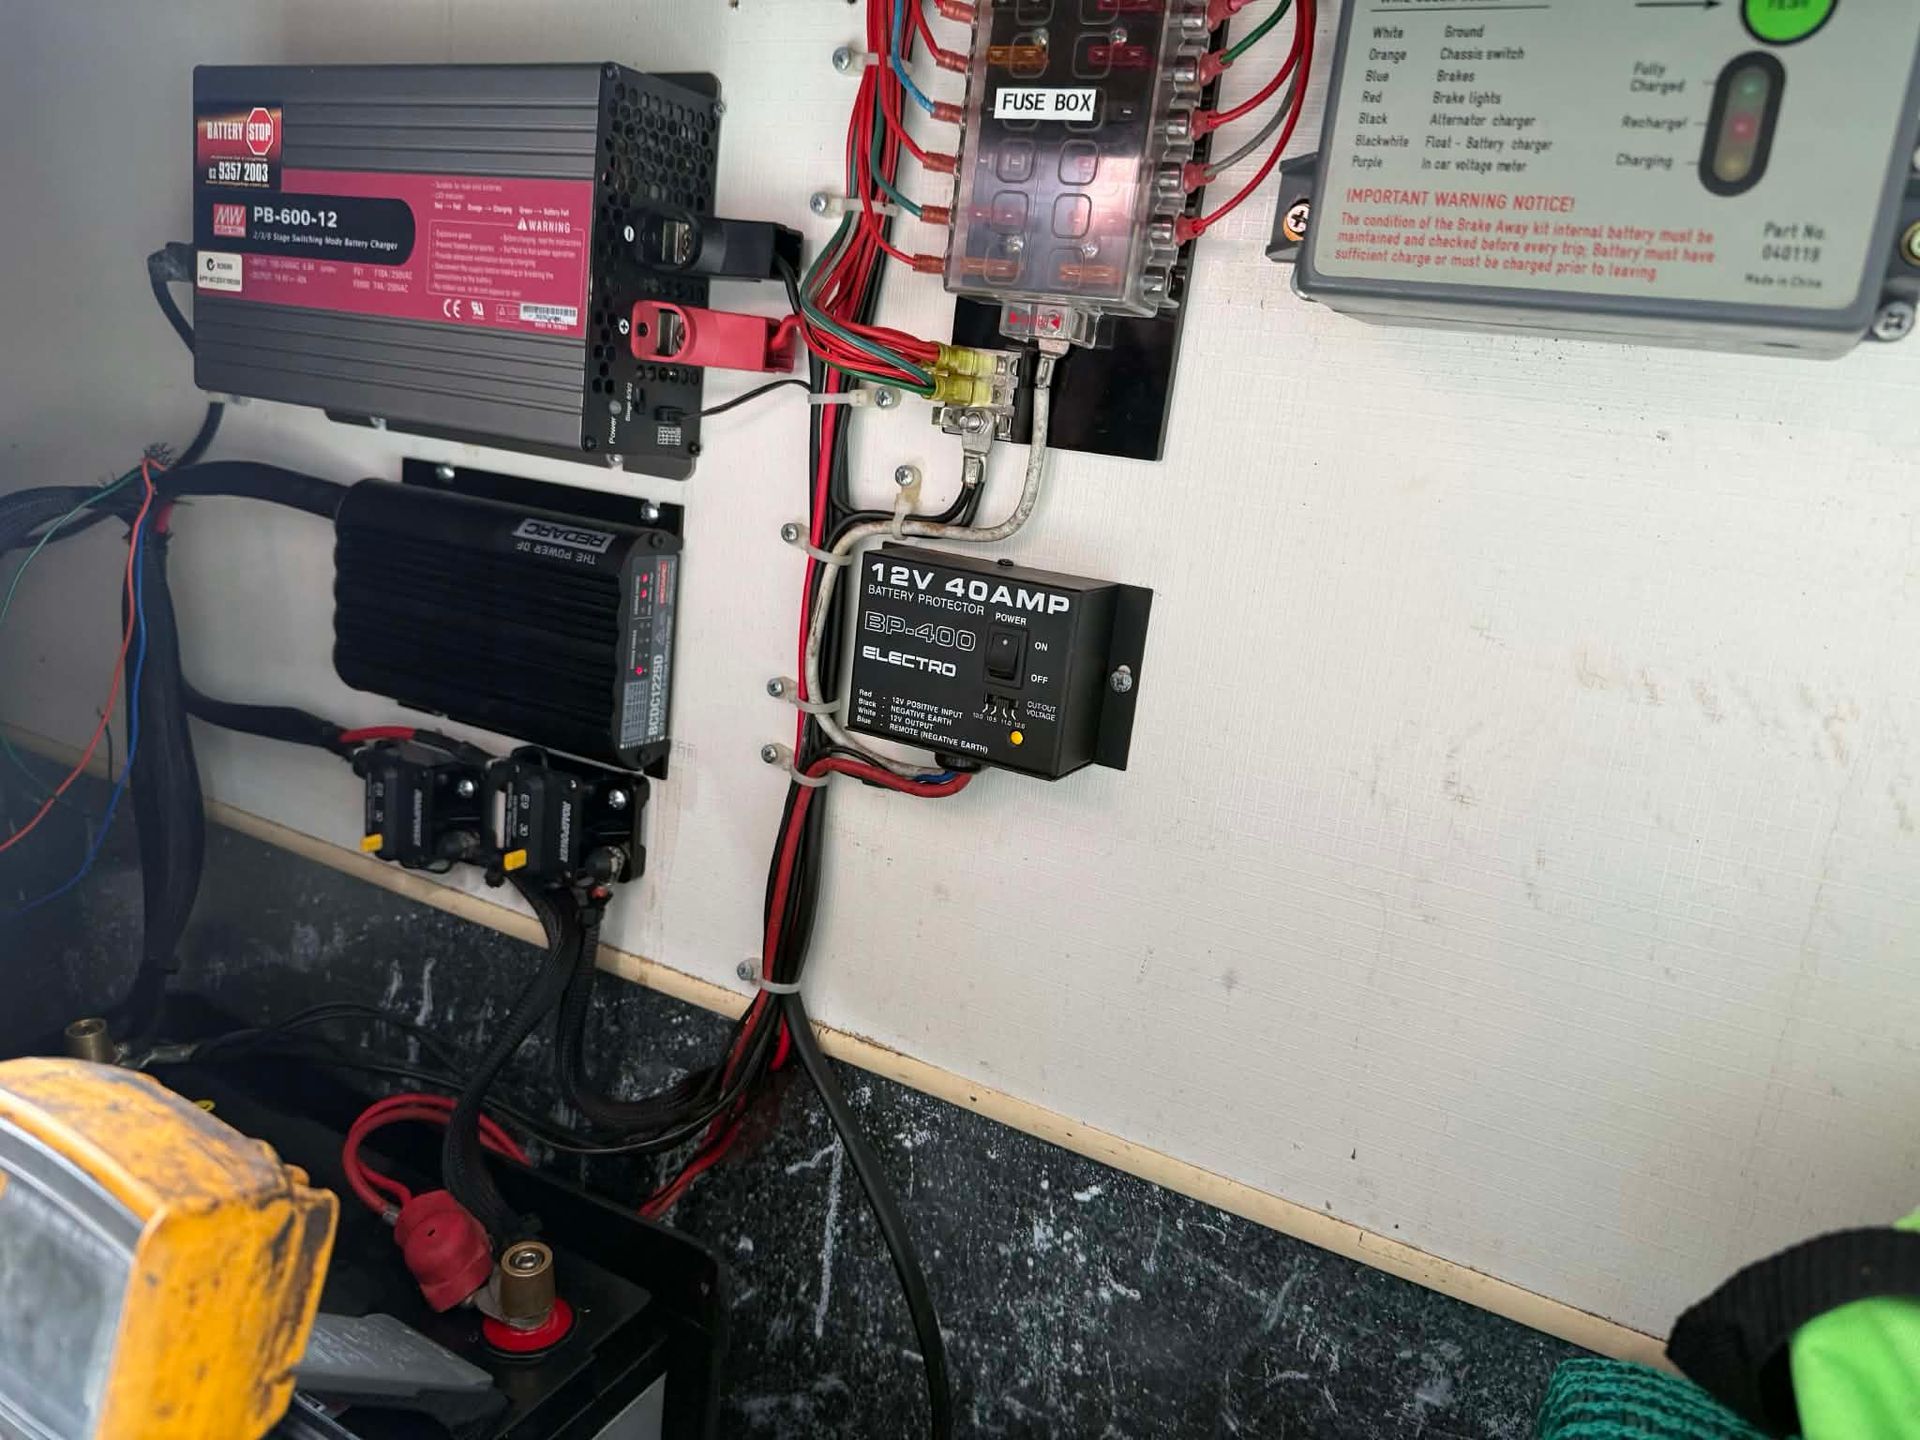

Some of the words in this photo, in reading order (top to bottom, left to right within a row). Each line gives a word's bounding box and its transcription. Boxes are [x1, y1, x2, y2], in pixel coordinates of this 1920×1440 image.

[1373, 26, 1404, 39] White
[1445, 25, 1485, 38] Ground
[1369, 49, 1407, 64] Orange
[1440, 48, 1483, 60] Chassis
[1487, 47, 1525, 60] switch
[1365, 70, 1389, 82] Blue
[1437, 70, 1475, 82] Brakes
[1630, 79, 1686, 96] Charged
[1002, 93, 1046, 111] FUSE
[1054, 94, 1093, 111] BOX
[1362, 91, 1383, 103] Red
[1433, 91, 1465, 104] Brake
[1469, 91, 1501, 107] lights
[1358, 113, 1388, 125] Black
[1429, 113, 1486, 126] Alternator
[1492, 115, 1536, 130] charger
[207, 121, 243, 140] BATTERY
[249, 123, 271, 142] STOP
[1356, 135, 1409, 148] Blackwhite
[1425, 136, 1451, 149] Float
[1465, 137, 1504, 152] Battery
[1511, 138, 1553, 153] charger
[1352, 156, 1383, 169] Purple
[1422, 158, 1432, 170] In
[1434, 160, 1450, 170] car
[1455, 158, 1492, 174] voltage
[1496, 160, 1527, 173] meter
[1616, 152, 1673, 171] Charging
[218, 161, 242, 181] 9357
[244, 163, 269, 182] 2003
[1346, 188, 1429, 206] IMPORTANT
[1435, 191, 1507, 210] WARNING
[1513, 195, 1576, 213] NOTICE!
[215, 205, 245, 226] MW
[254, 206, 337, 228] PB-600-12
[529, 219, 571, 234] WARNING
[1341, 212, 1359, 226] The
[1363, 213, 1416, 229] condition
[1419, 216, 1430, 229] of
[1435, 217, 1453, 230] the
[1458, 218, 1491, 233] Brake
[1495, 221, 1528, 237] Away
[1533, 222, 1550, 235] kit
[1553, 223, 1603, 239] internal
[1607, 225, 1655, 245] battery
[1659, 229, 1692, 243] must
[1697, 230, 1714, 244] be
[1764, 220, 1798, 239] Part
[273, 232, 290, 243] Stage
[292, 234, 322, 246] Switching
[344, 238, 368, 249] Battery
[370, 240, 398, 251] Charger
[1337, 231, 1400, 245] maintained
[1404, 234, 1425, 247] and
[1428, 235, 1477, 249] checked
[1481, 238, 1519, 251] before
[1524, 242, 1557, 257] every
[1593, 243, 1641, 262] Battery
[1645, 248, 1678, 261] must
[1683, 250, 1715, 263] have
[1334, 248, 1388, 262] sufficient
[1391, 250, 1431, 268] charge
[1434, 255, 1447, 266] or
[1451, 254, 1480, 267] must
[1484, 257, 1499, 269] be
[1502, 258, 1552, 276] charged
[1555, 261, 1587, 276] prior
[1592, 263, 1604, 276] to
[1609, 263, 1657, 283] leaving
[443, 299, 461, 318] CE
[608, 416, 616, 444] Power
[524, 523, 607, 547] REDARC
[515, 541, 531, 551] OF
[534, 544, 572, 560] POWER
[576, 552, 595, 565] THE
[871, 563, 934, 590] 12V
[945, 577, 1070, 615] 40AMP
[868, 584, 915, 603] BATTERY
[918, 594, 985, 616] PROTECTOR
[995, 612, 1027, 626] POWER
[864, 611, 976, 652] BP-400
[1034, 641, 1048, 652] ON
[862, 645, 957, 678] ELECTRO
[1031, 673, 1048, 684] OFF
[648, 654, 664, 736] BCDC1225D
[859, 688, 873, 698] Red
[892, 696, 905, 706] 12V
[906, 699, 939, 714] POSITIVE
[941, 708, 963, 719] INPUT
[858, 697, 877, 708] Black
[890, 705, 925, 720] NEGATIVE
[927, 713, 952, 726] EARTH
[858, 706, 876, 717] White
[890, 714, 902, 723] 12V
[904, 718, 934, 730] OUTPUT
[1026, 709, 1056, 722] VOLTAGE
[856, 715, 872, 725] Blue
[889, 723, 918, 736] REMOTE
[920, 731, 958, 746] (NEGATIVE
[960, 741, 988, 755] EARTH)
